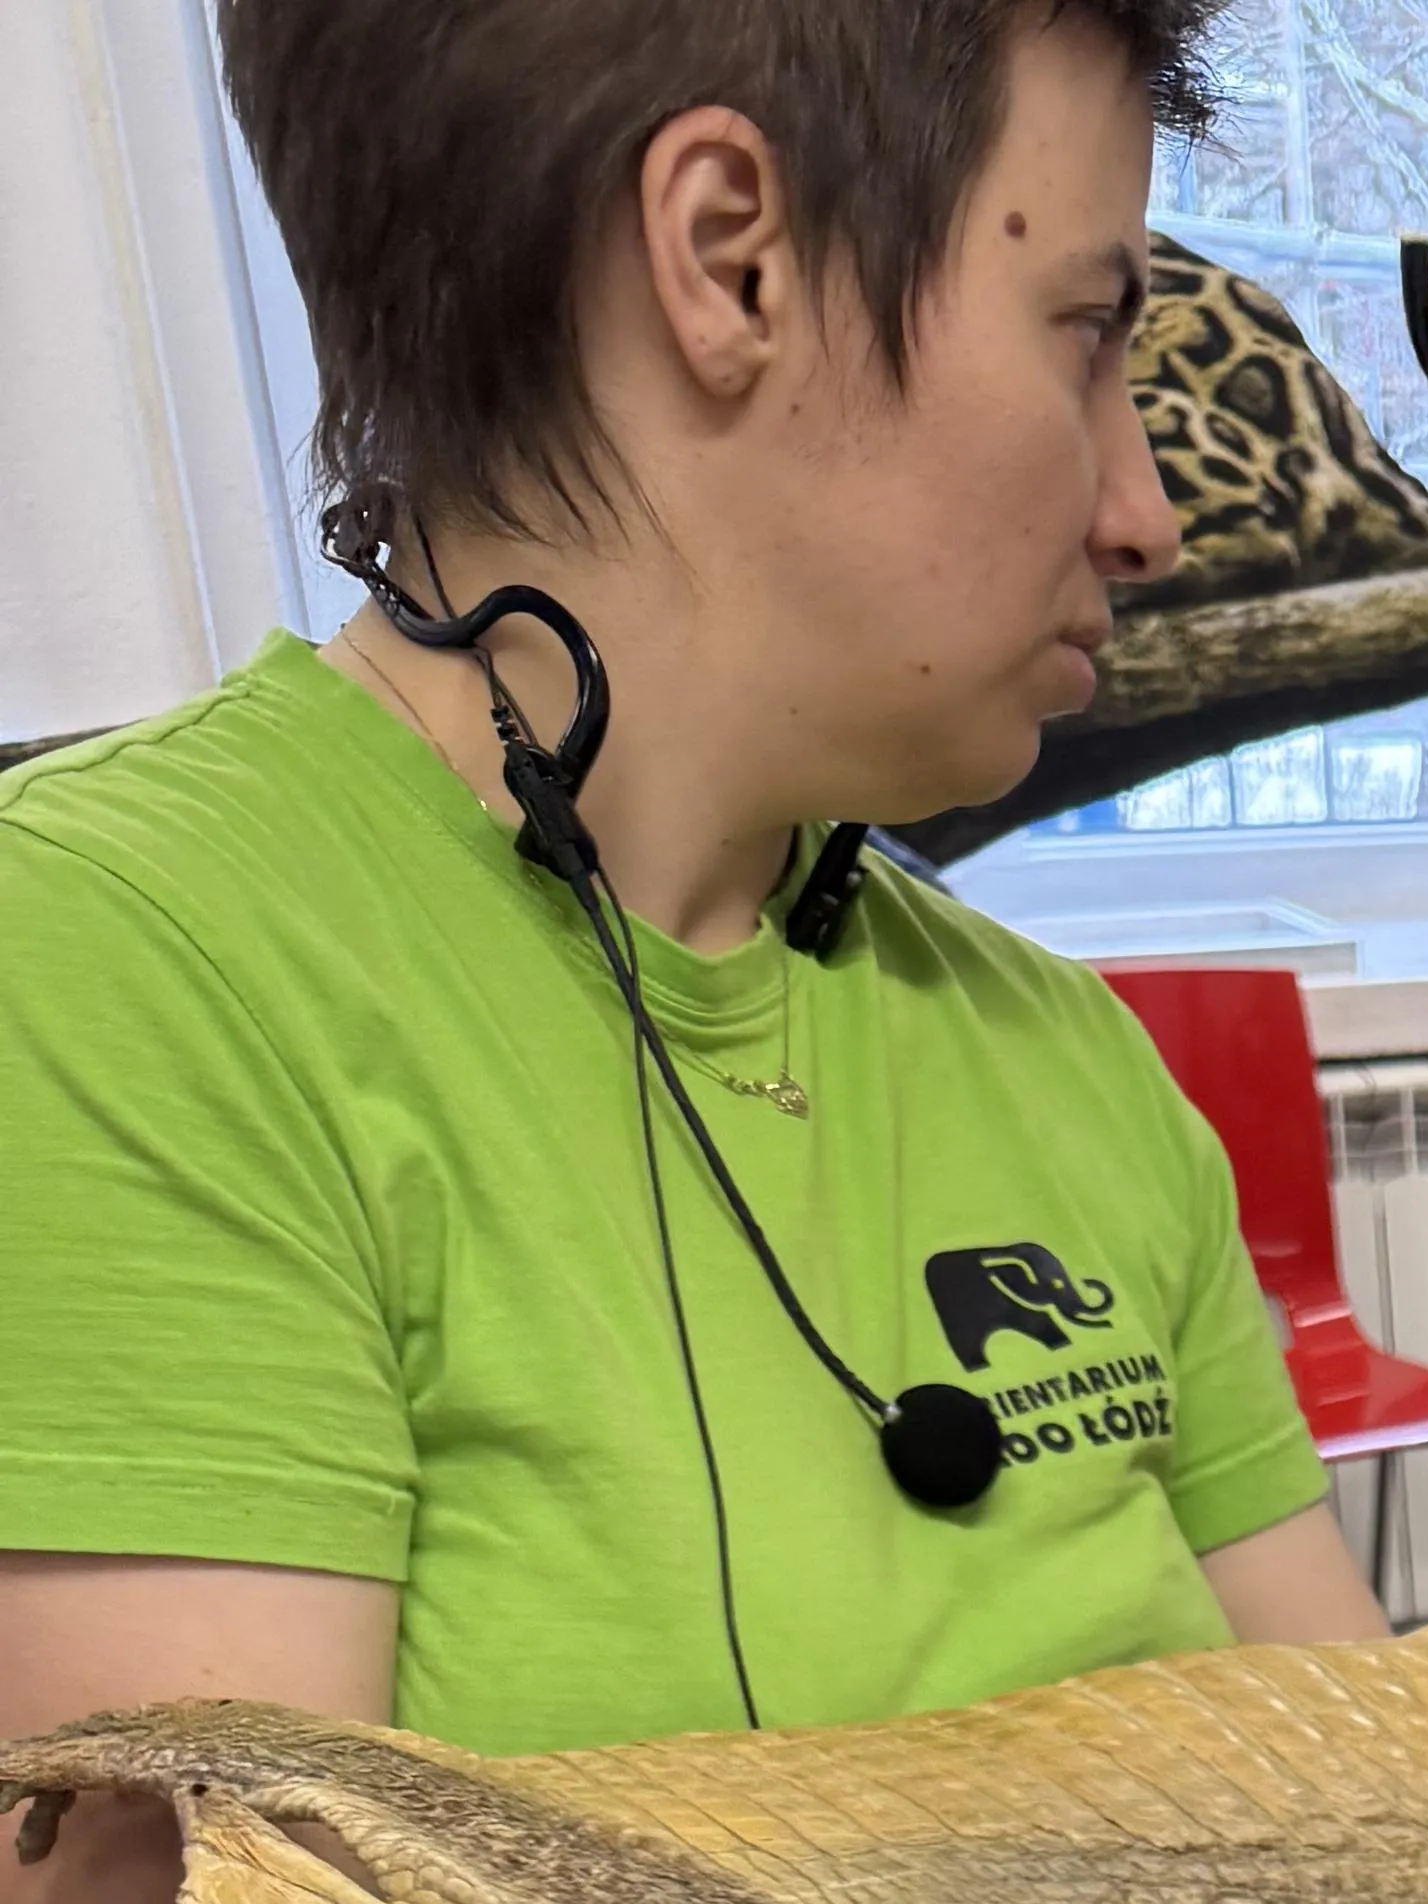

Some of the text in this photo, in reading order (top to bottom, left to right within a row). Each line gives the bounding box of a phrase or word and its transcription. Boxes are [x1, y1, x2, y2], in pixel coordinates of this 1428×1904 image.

[985, 1354, 1167, 1420] IENTARIUM
[1000, 1386, 1172, 1468] OO ŁÓDŹ
